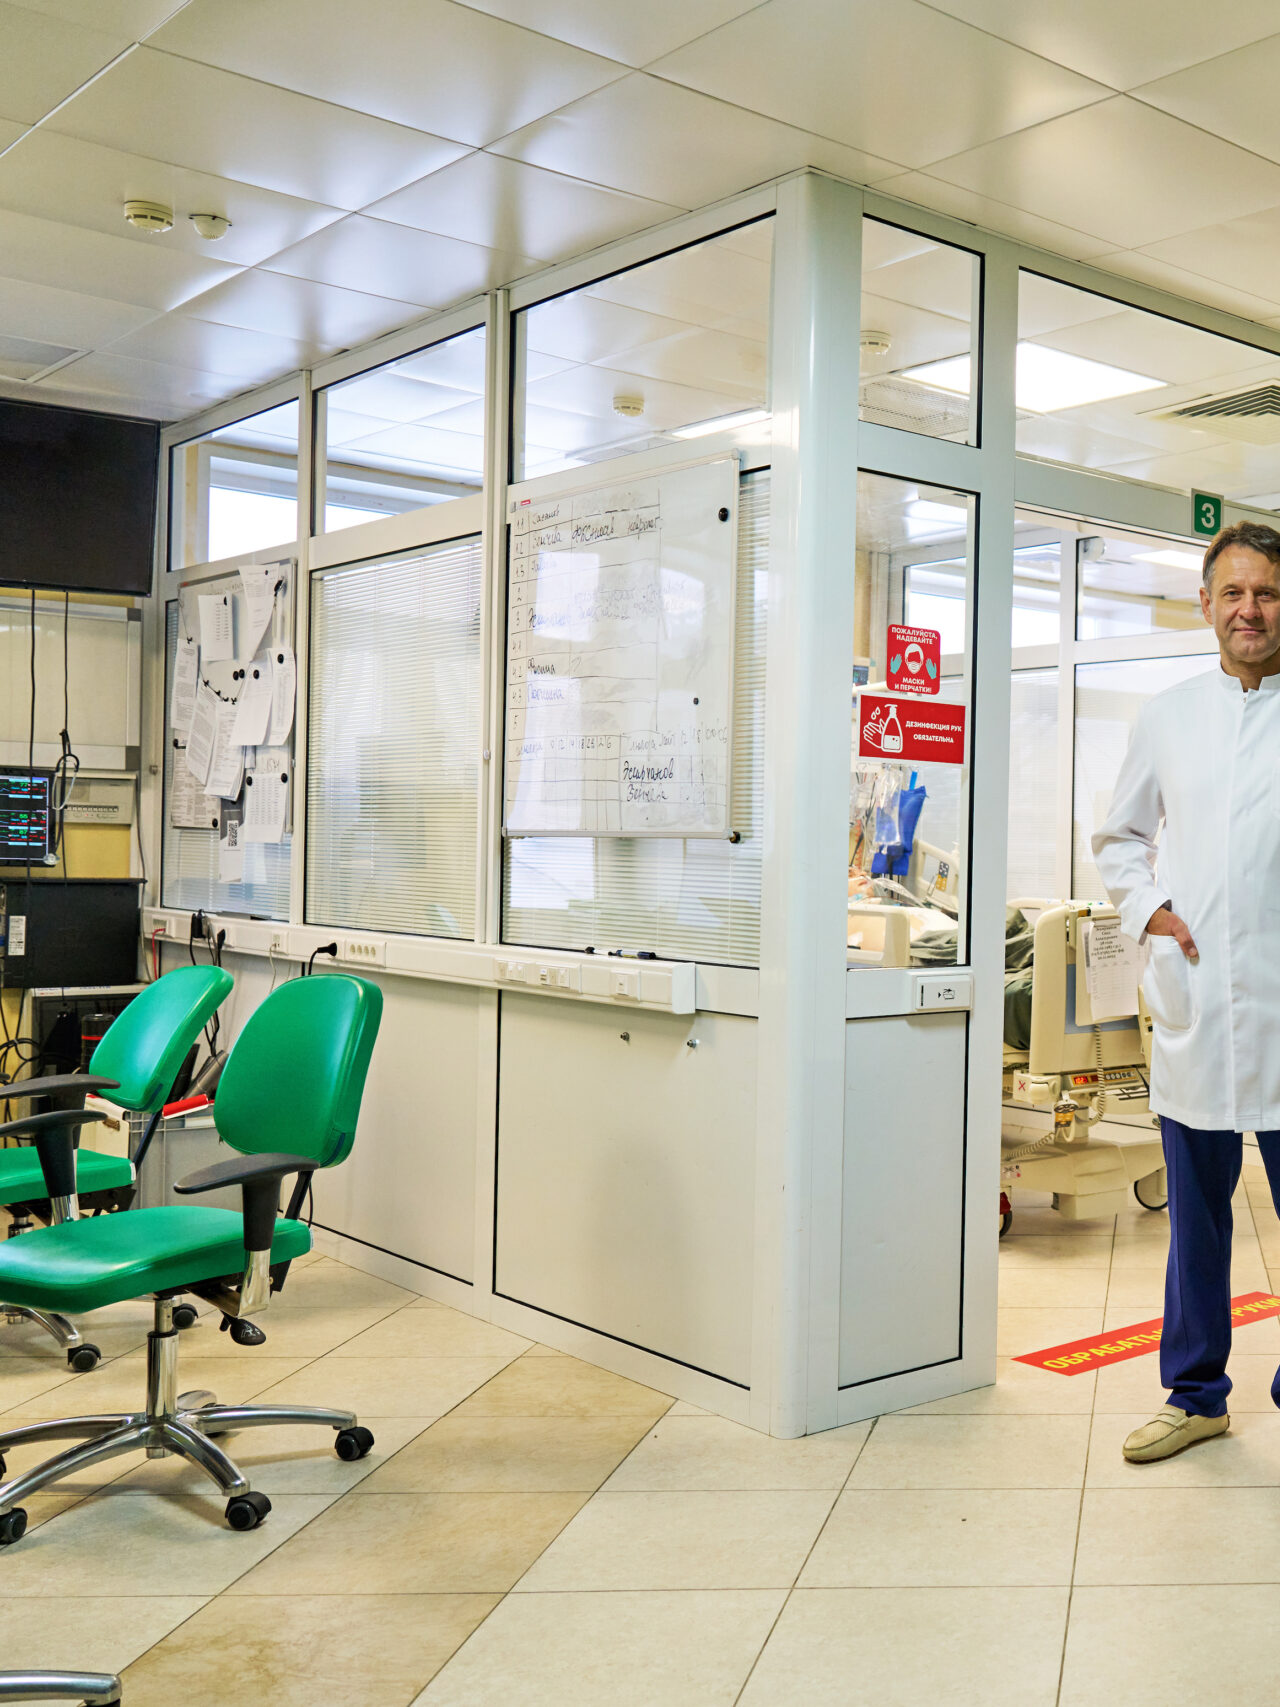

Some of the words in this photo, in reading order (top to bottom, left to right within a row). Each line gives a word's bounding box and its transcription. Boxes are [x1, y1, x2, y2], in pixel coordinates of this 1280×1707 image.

[1201, 502, 1215, 529] 3
[892, 626, 938, 640] ПОЖАЛУЙСТА,
[896, 634, 933, 645] НАДЕВАЙТЕ
[902, 677, 925, 685] МАСКИ
[900, 684, 932, 693] ПЕРЧАТКИ!
[905, 720, 950, 731] ДЕЗИНФЕКЦИЯ
[913, 734, 954, 743] ОБЯЗАТЕЛЬНА
[1042, 1328, 1164, 1369] ОБРАБАТЫ
